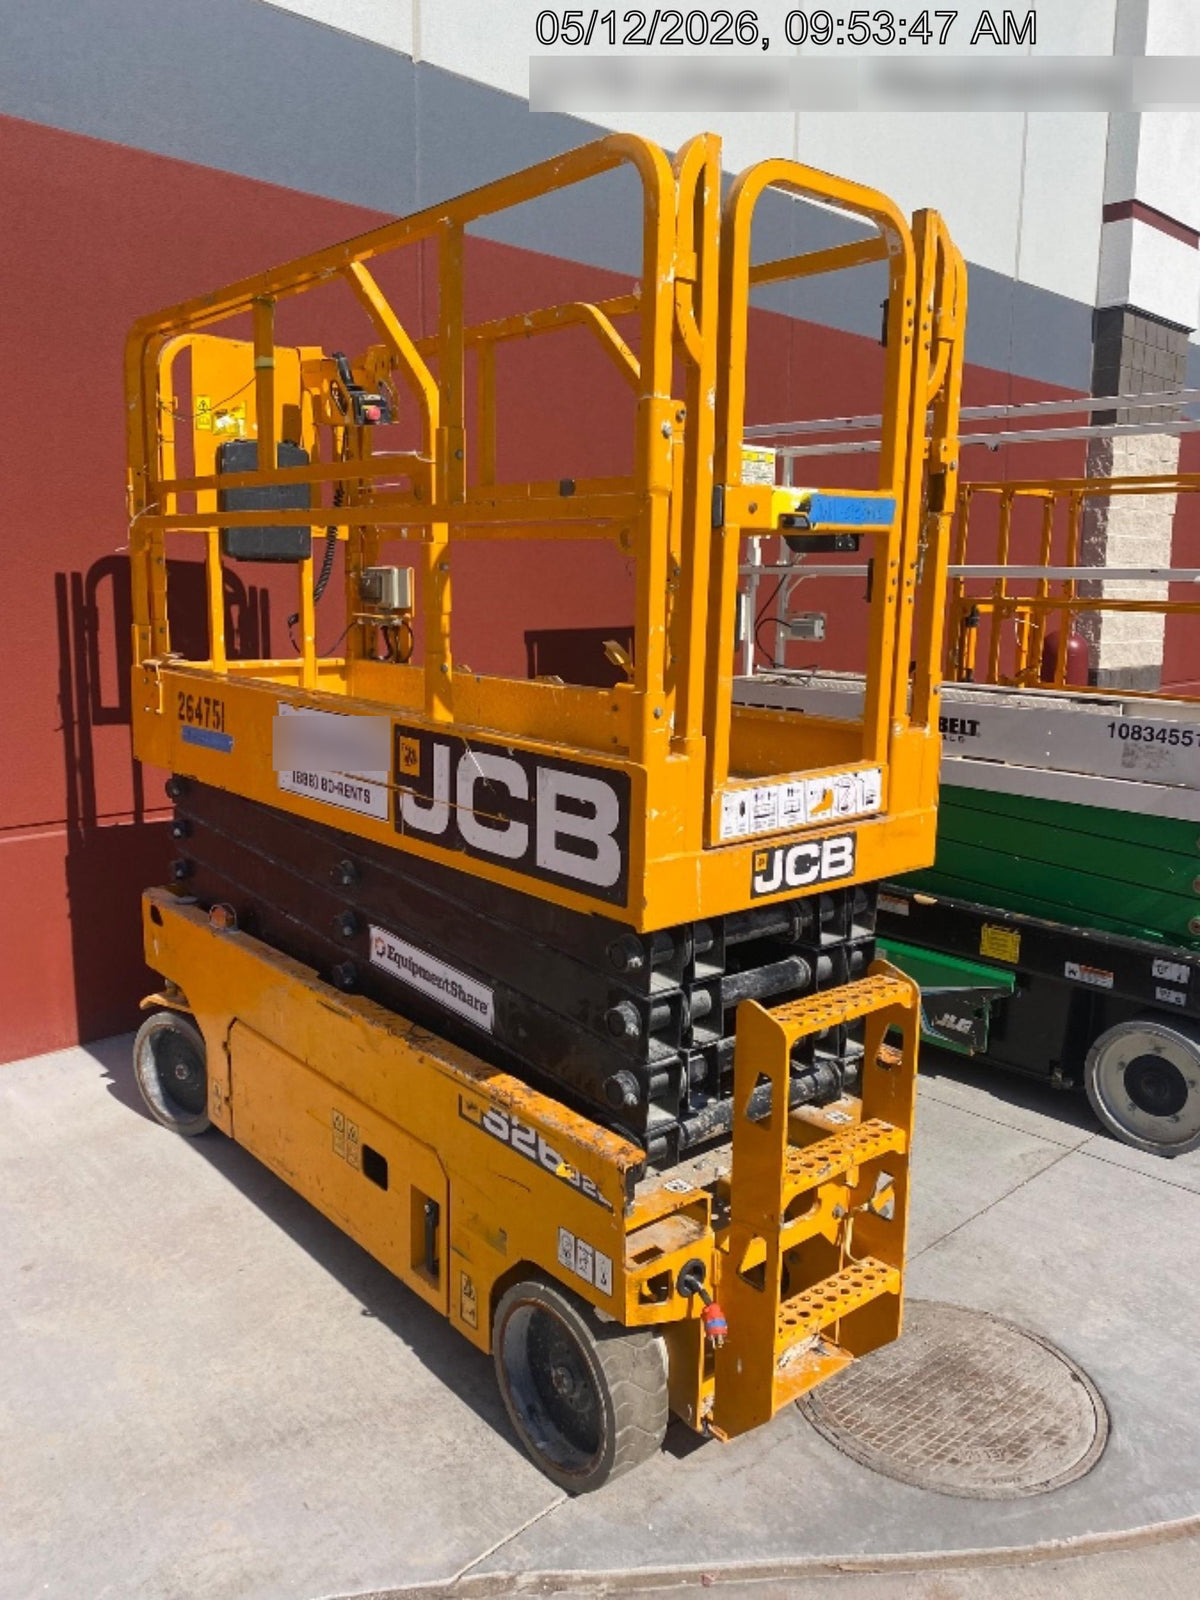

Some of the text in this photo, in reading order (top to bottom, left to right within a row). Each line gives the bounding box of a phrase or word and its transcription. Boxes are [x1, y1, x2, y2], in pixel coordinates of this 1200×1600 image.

[178, 690, 225, 733] 264751
[400, 741, 622, 889] JCB
[753, 835, 856, 895] JCB
[386, 942, 489, 1015] EquipmentShare
